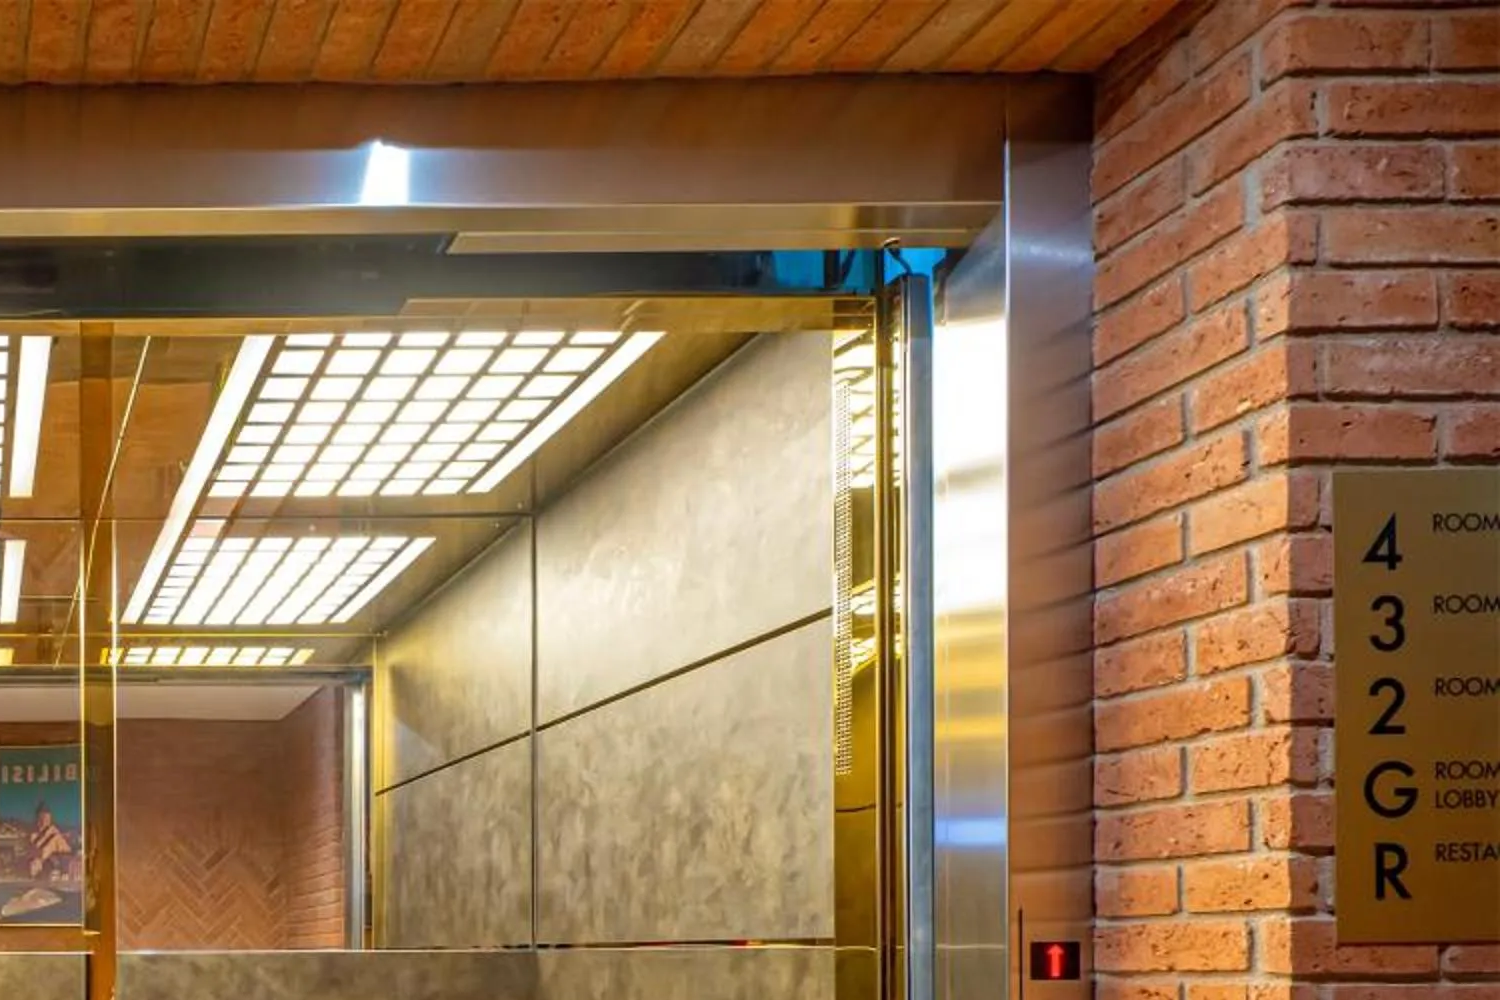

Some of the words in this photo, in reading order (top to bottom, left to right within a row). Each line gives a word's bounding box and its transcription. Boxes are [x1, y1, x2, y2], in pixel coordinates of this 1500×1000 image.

[1361, 512, 1403, 571] 4
[1369, 594, 1406, 653] 3
[1368, 677, 1406, 735] 2
[1363, 760, 1418, 818] G
[1435, 789, 1499, 810] LOBBY
[1374, 842, 1412, 900] R
[1435, 842, 1500, 863] RESTA
